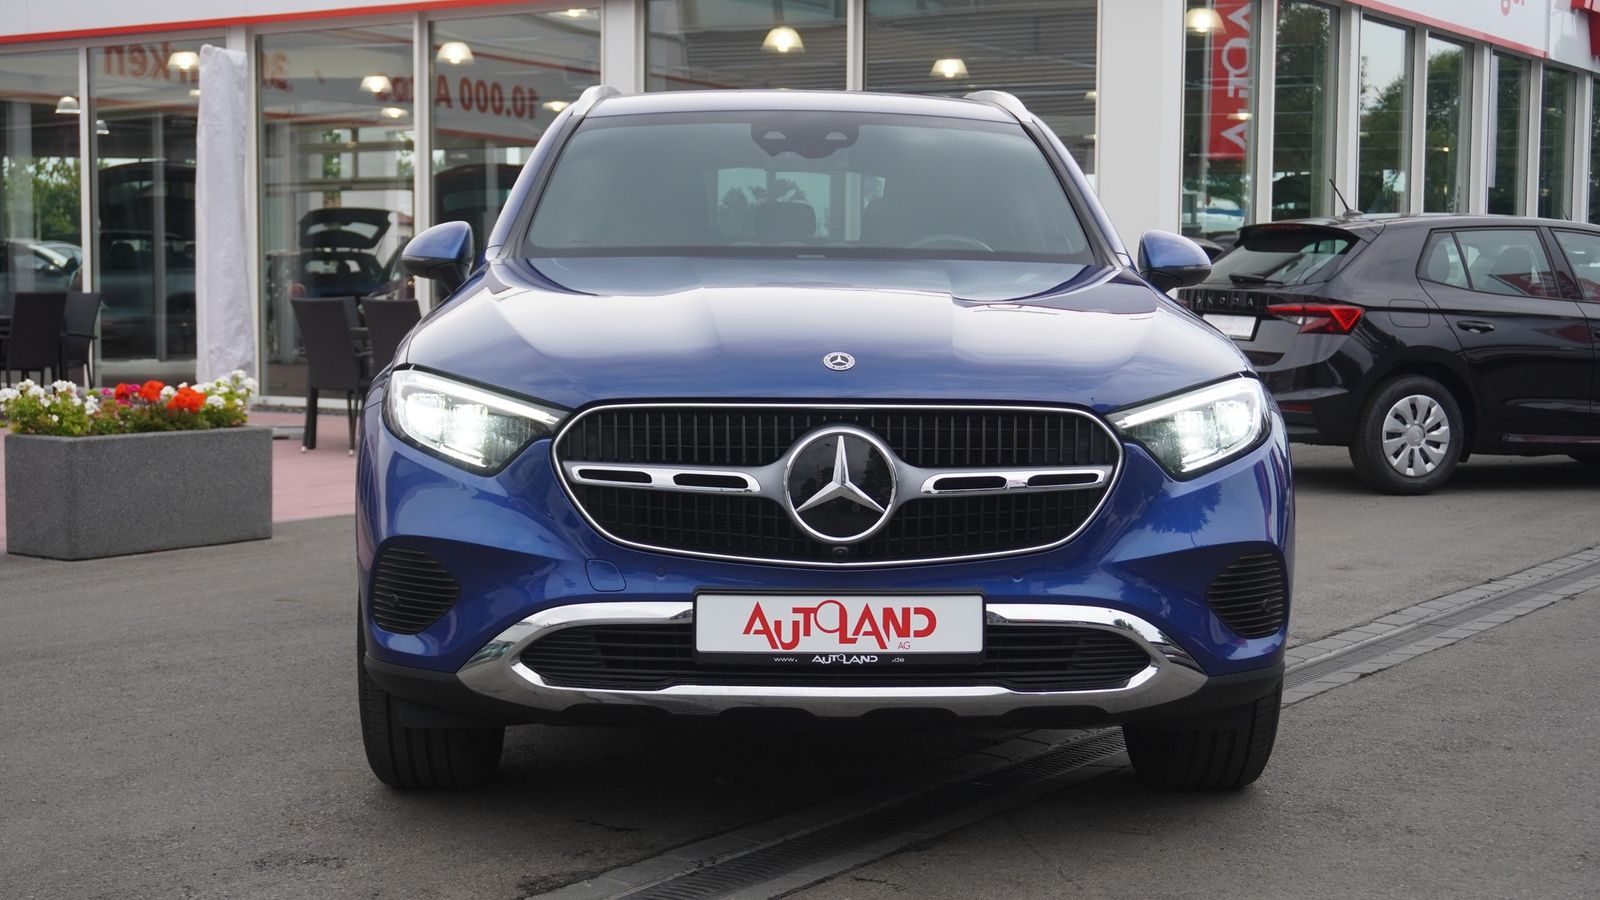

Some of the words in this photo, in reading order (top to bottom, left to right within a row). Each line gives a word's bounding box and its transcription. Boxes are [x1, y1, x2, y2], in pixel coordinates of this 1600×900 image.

[742, 599, 937, 650] AUTOLAND
[897, 641, 911, 650] AG
[811, 653, 879, 664] AUTOLAND
